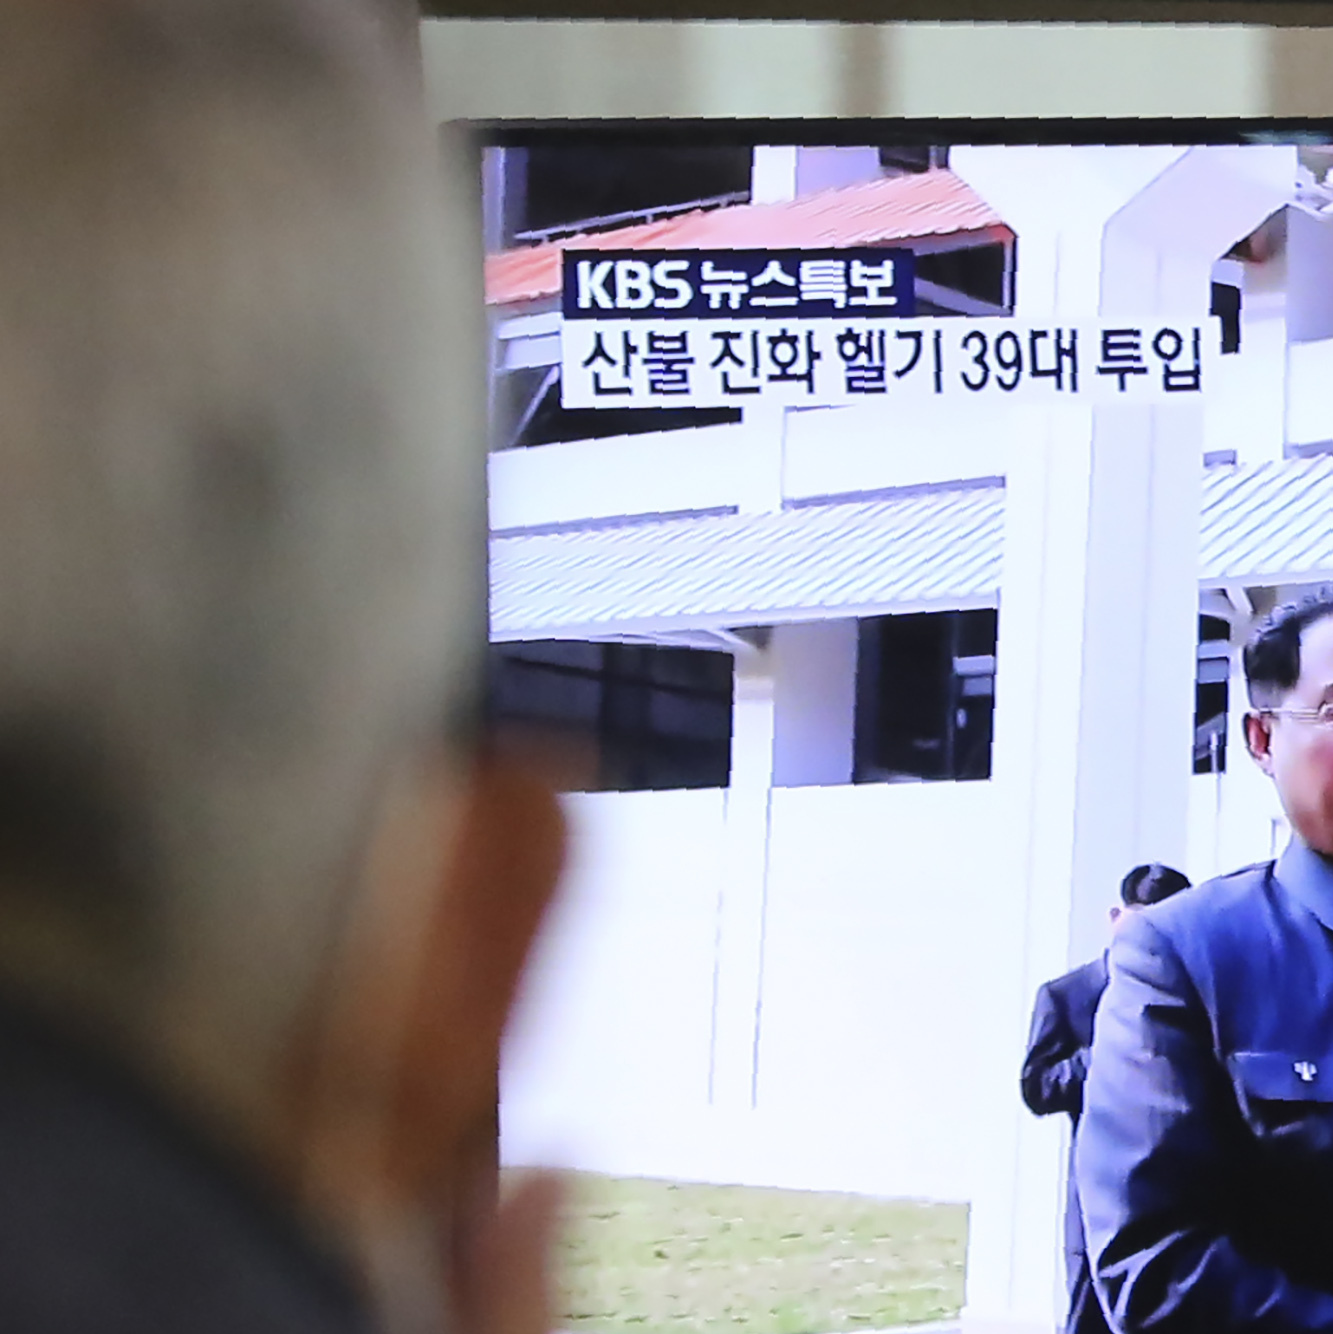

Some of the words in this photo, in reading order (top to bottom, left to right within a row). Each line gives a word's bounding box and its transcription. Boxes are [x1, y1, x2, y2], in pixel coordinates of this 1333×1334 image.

[577, 259, 692, 309] KBS
[700, 259, 898, 309] 뉴스특보
[582, 330, 694, 395] 산불
[710, 328, 821, 395] 진화
[835, 328, 943, 394] 헬기
[960, 328, 1078, 392] 39대
[1096, 327, 1202, 392] 투입
